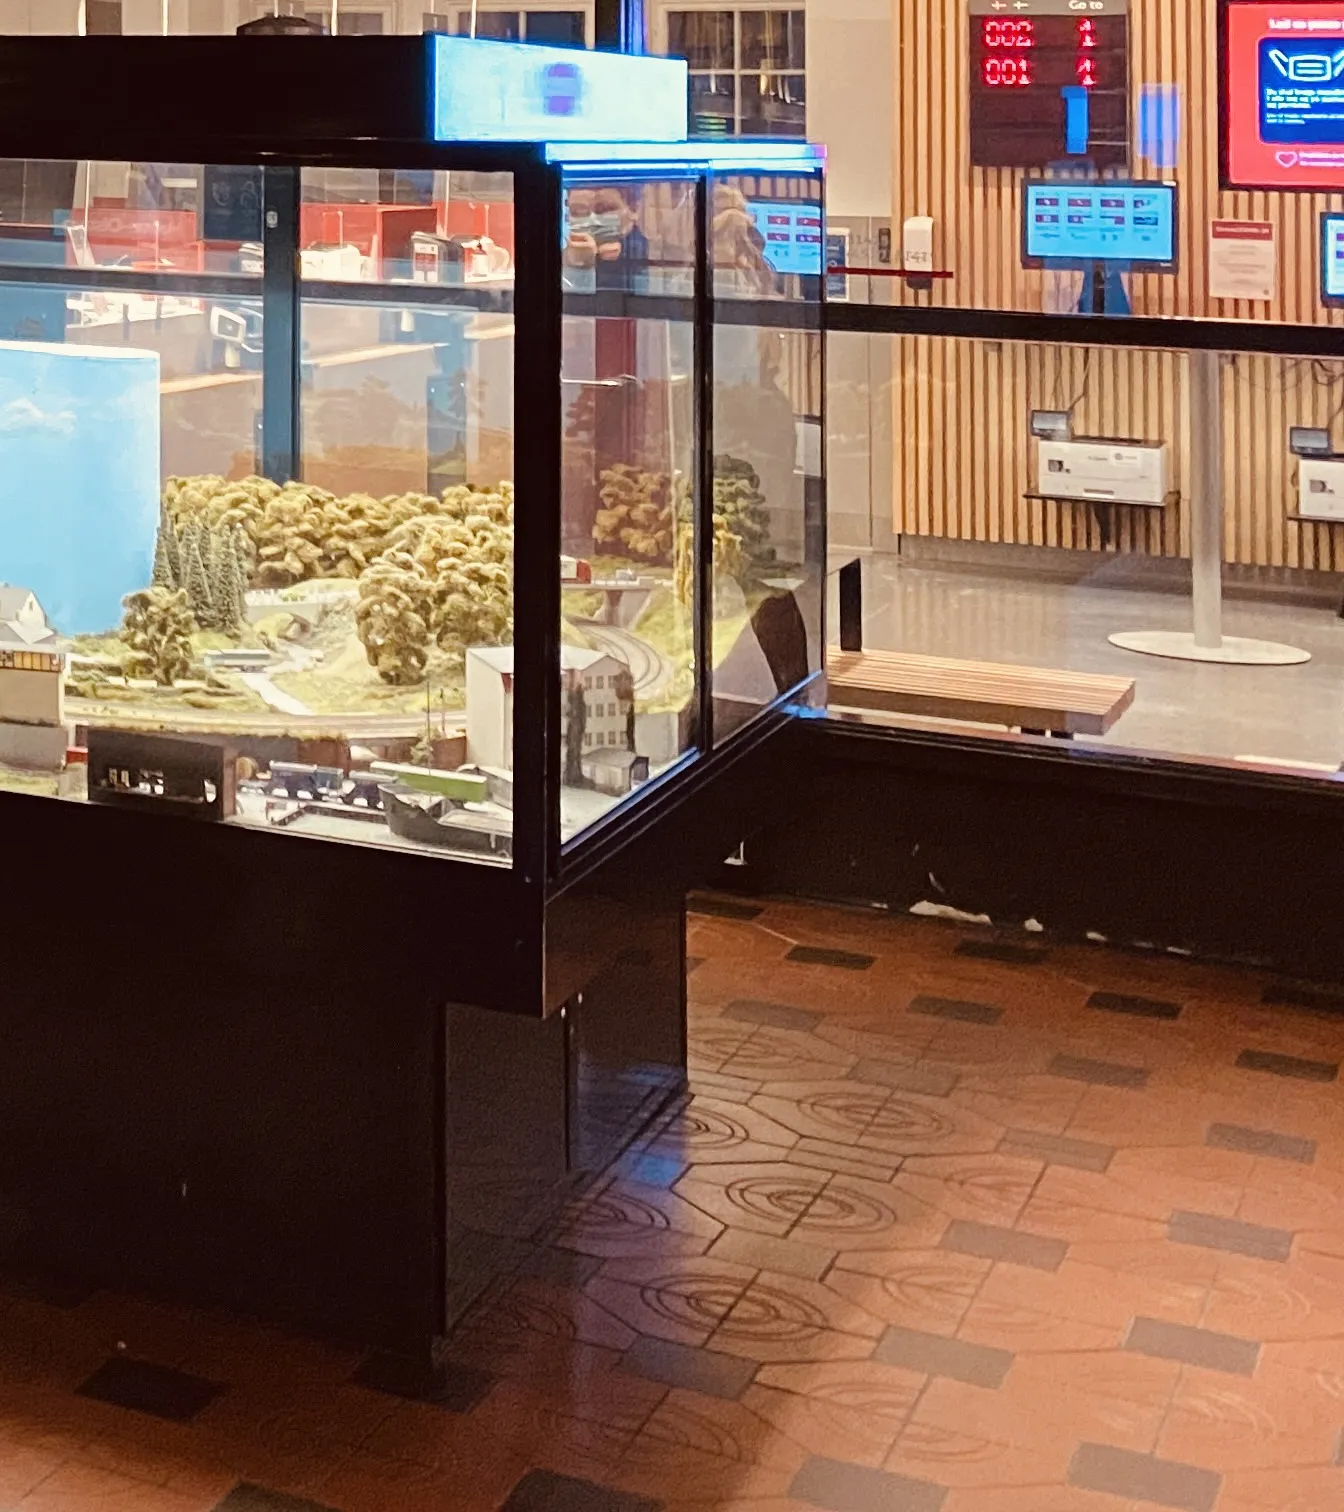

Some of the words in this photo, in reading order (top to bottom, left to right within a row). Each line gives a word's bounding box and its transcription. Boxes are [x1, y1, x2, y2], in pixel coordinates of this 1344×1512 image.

[1068, 0, 1087, 10] Go
[1089, 1, 1104, 10] to
[985, 20, 1033, 47] 002
[986, 59, 1031, 85] 001
